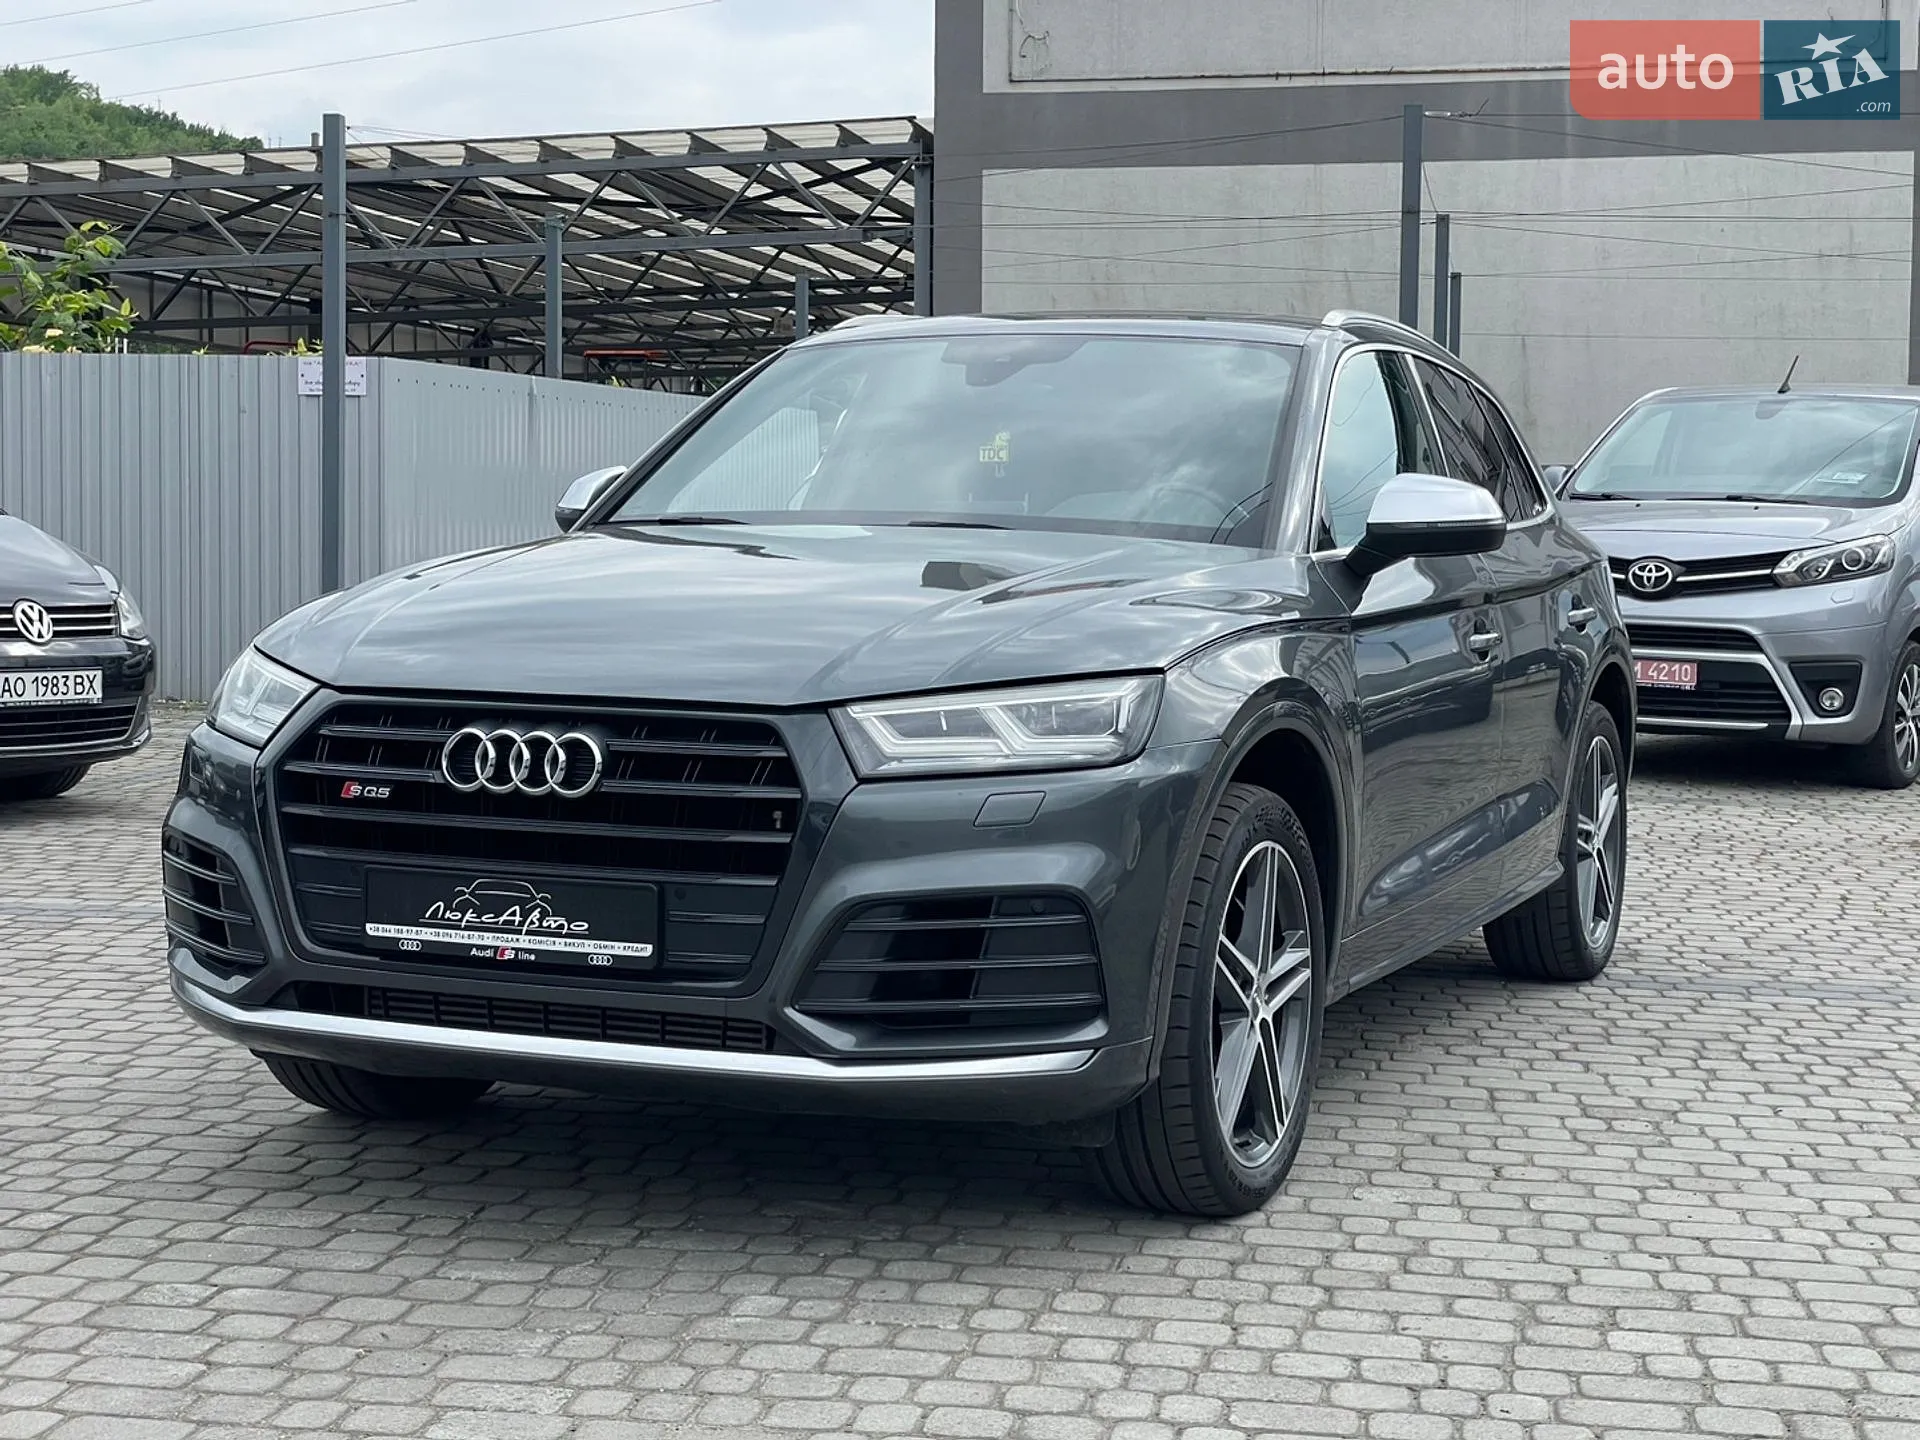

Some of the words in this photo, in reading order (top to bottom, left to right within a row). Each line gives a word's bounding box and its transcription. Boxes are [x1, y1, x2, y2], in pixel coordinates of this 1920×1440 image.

[1647, 662, 1692, 681] 4210
[1, 676, 27, 699] AO
[31, 675, 70, 697] 1983
[74, 674, 98, 696] BX
[347, 784, 391, 799] SQ5
[470, 947, 495, 958] Audi
[518, 950, 536, 961] line
